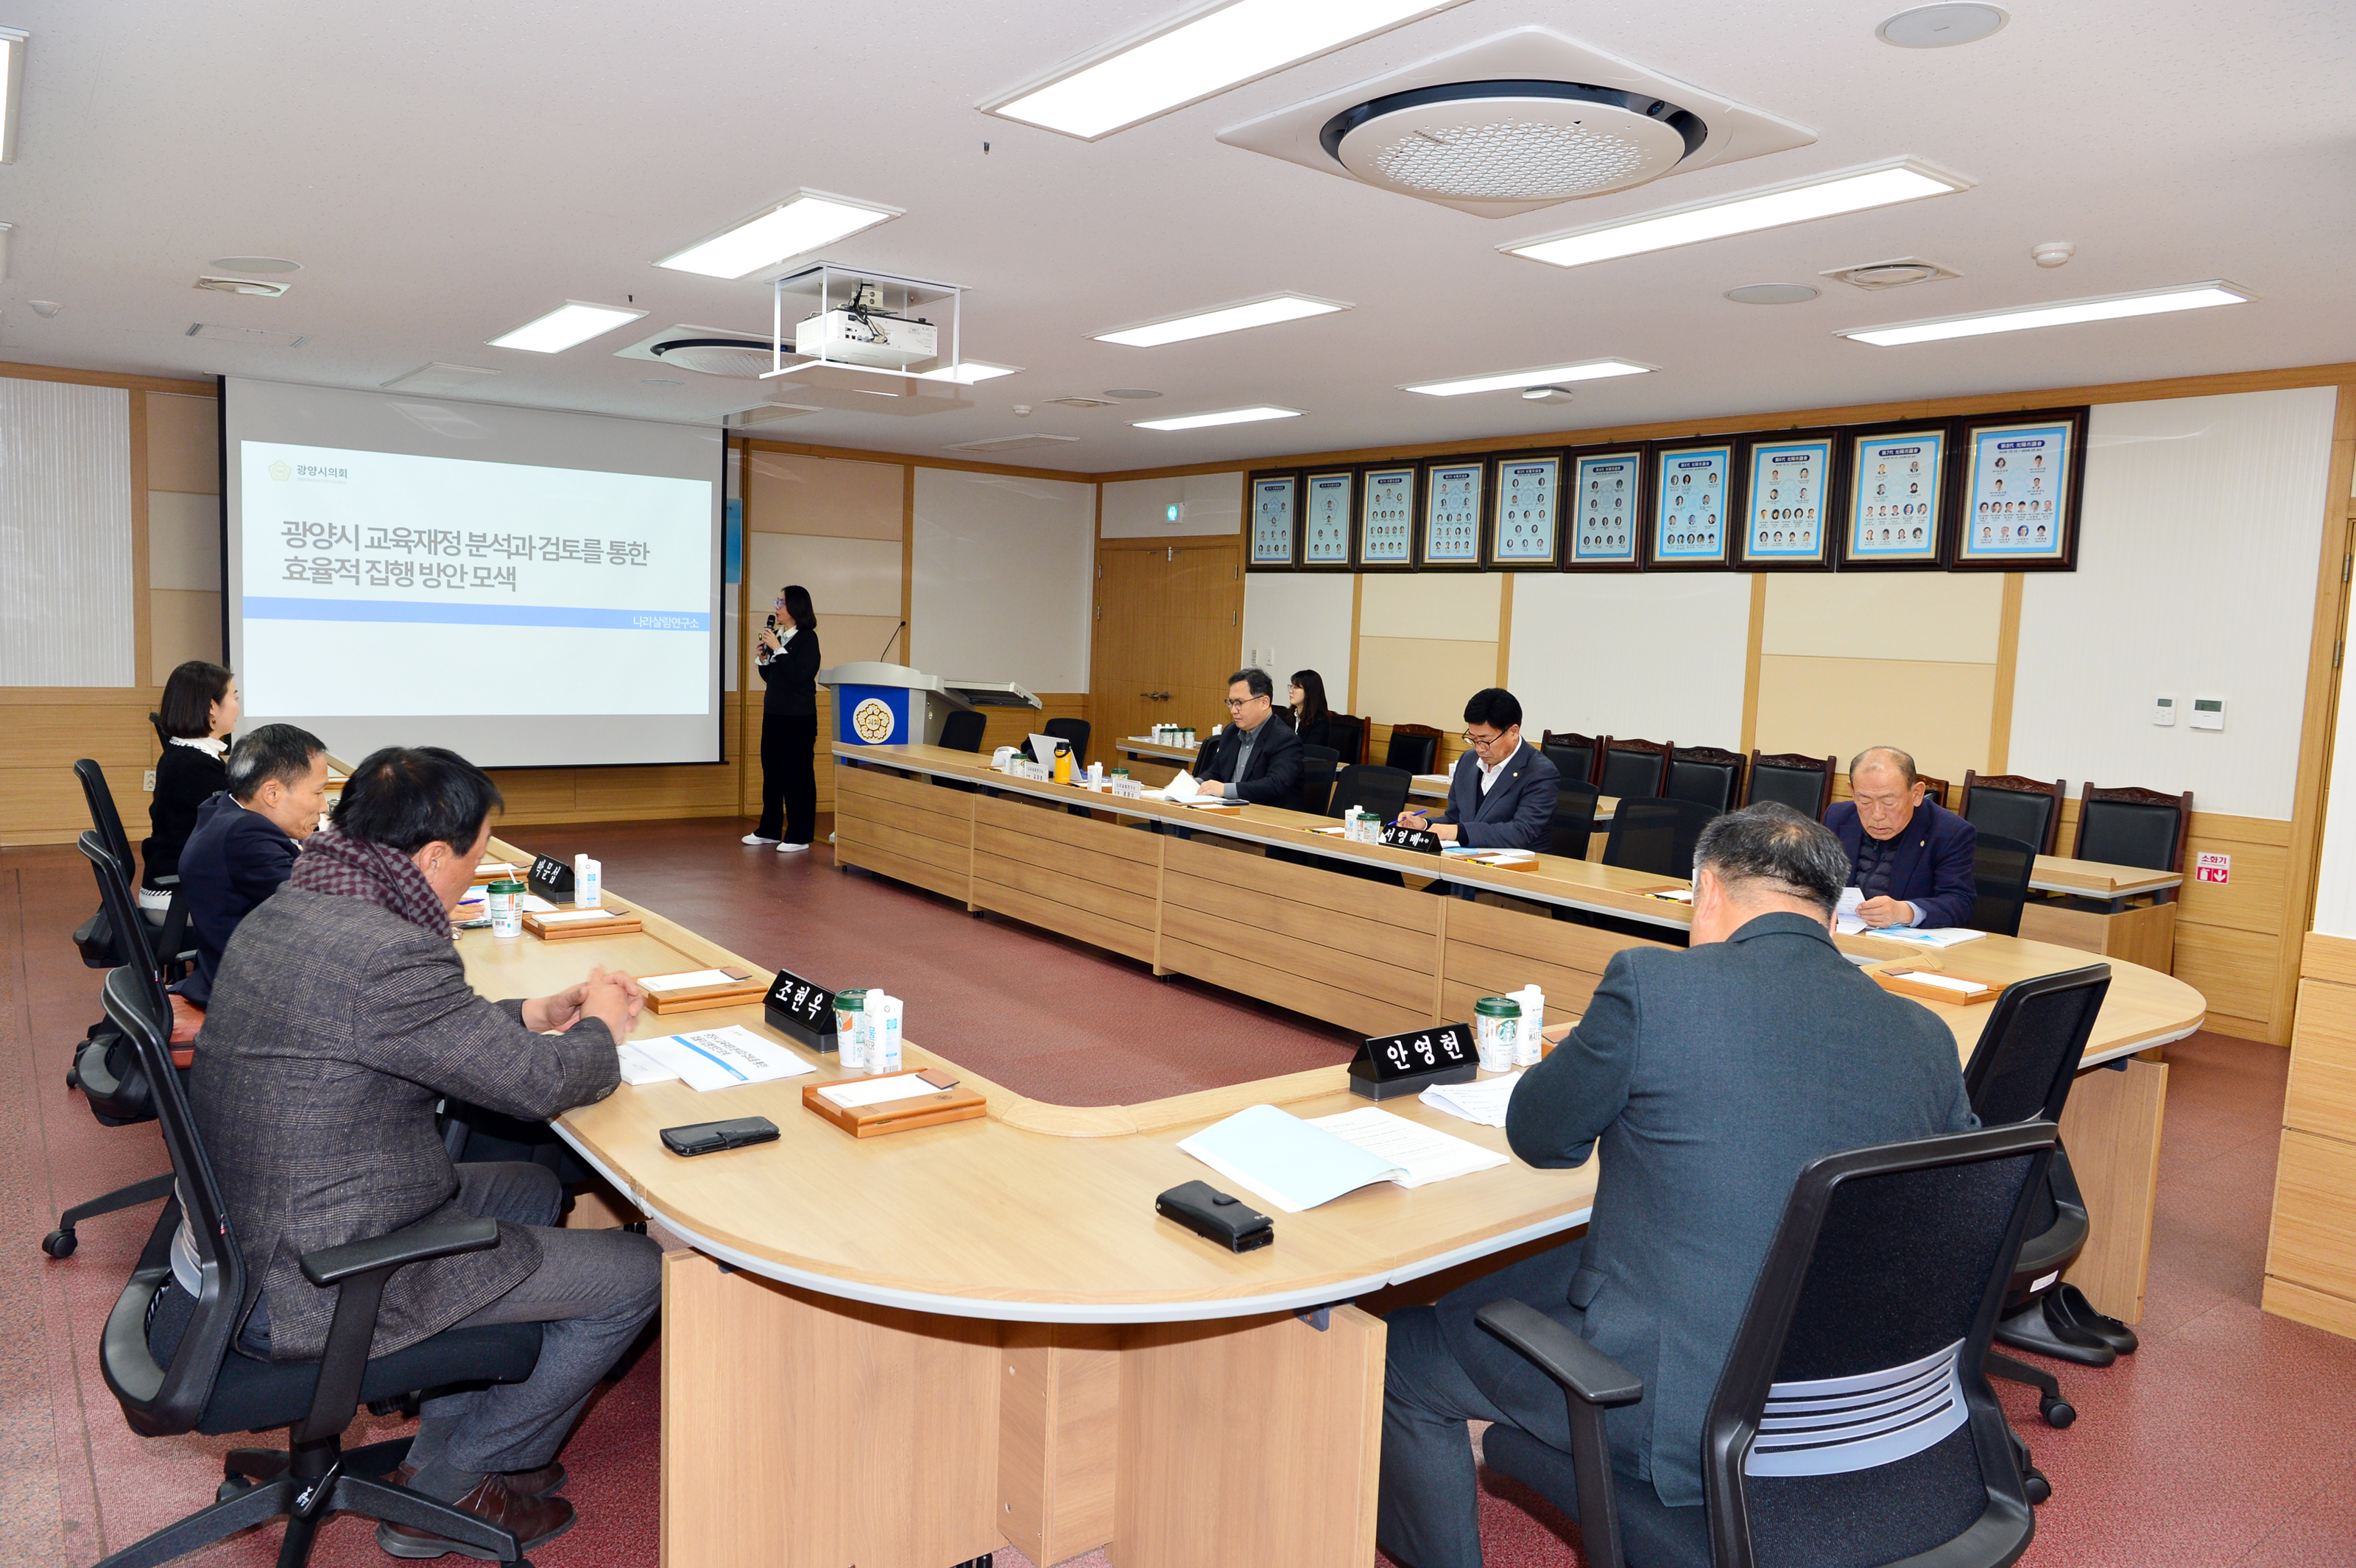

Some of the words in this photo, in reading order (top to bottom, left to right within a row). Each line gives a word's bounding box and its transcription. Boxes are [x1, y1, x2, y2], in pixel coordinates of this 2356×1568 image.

[1413, 130, 1445, 144] SAMSUNG
[296, 465, 348, 478] 광양시의회
[281, 520, 359, 551] 광양시
[364, 526, 462, 557] 교육재정
[465, 532, 536, 561] 분석과
[538, 537, 604, 564] 검토를
[606, 540, 650, 566] 통한
[282, 556, 360, 586] 효율적
[364, 559, 415, 587] 집행
[419, 562, 468, 589] 방안
[469, 566, 516, 593] 모색
[633, 615, 699, 629] 나라살림연구소
[1384, 827, 1422, 847] 서영배
[2201, 855, 2227, 864] 소화기
[535, 859, 562, 885] 박문섭
[775, 980, 824, 1020] 조현옥
[1386, 1031, 1464, 1070] 안영헌
